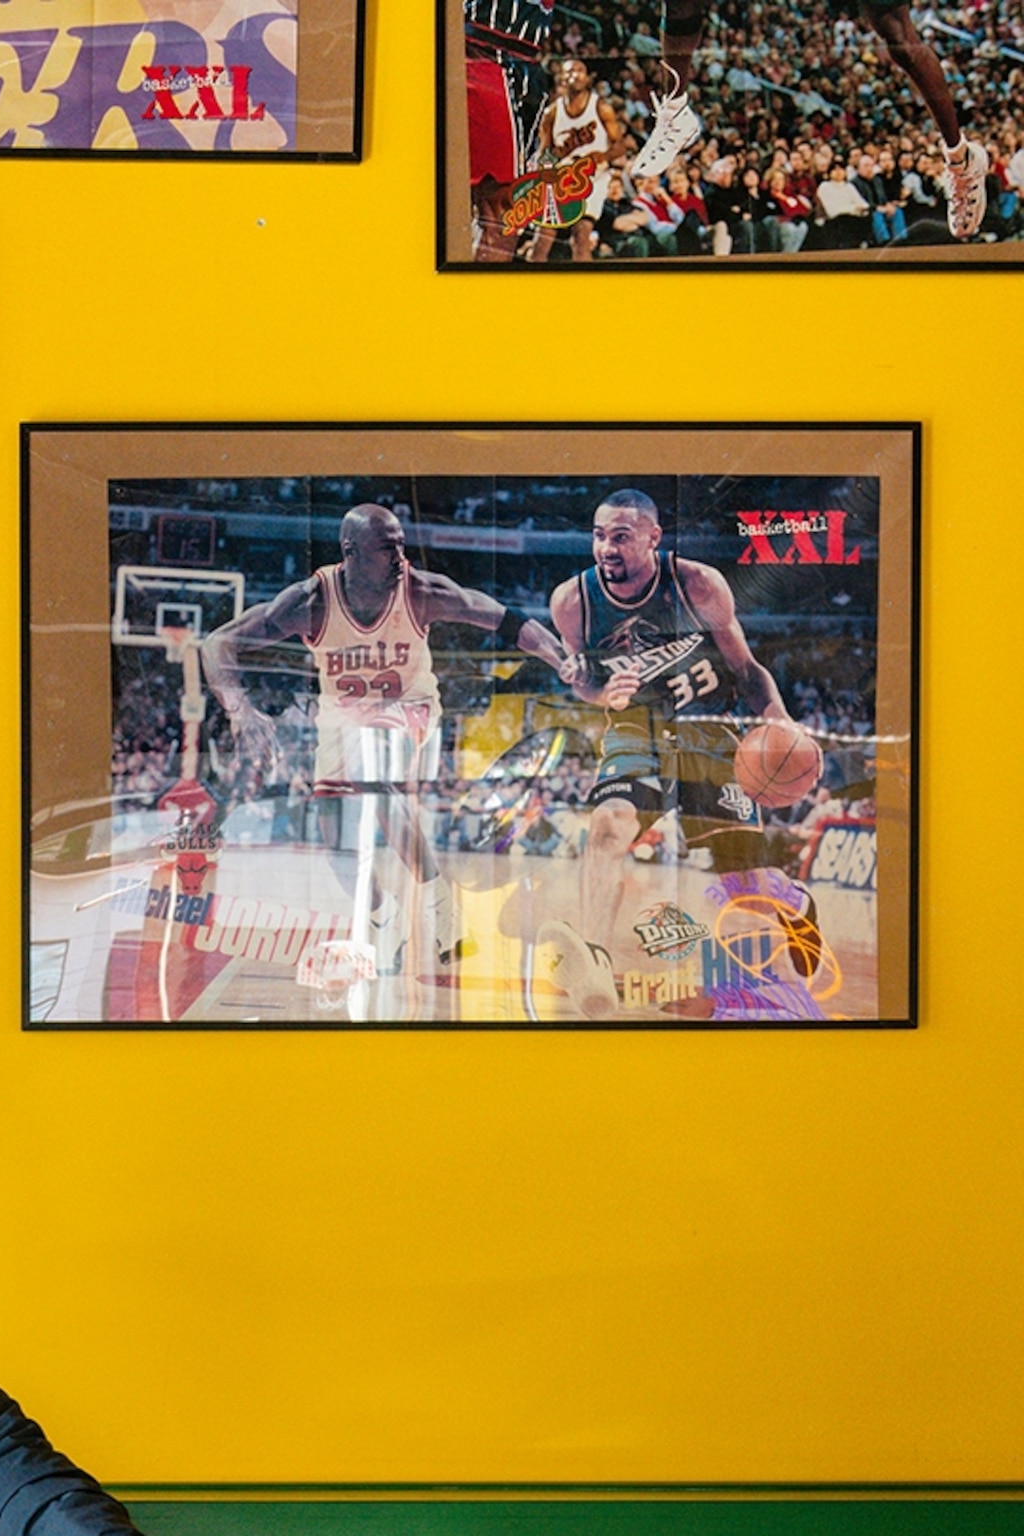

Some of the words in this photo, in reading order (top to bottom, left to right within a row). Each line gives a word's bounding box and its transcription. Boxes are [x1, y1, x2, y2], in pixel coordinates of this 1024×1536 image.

[141, 65, 267, 121] XXL
[736, 510, 863, 565] XXL
[737, 516, 828, 537] basketball
[326, 640, 411, 677] BULLS
[666, 658, 720, 711] 33
[635, 923, 710, 946] PISTONS
[624, 961, 698, 1010] Grant
